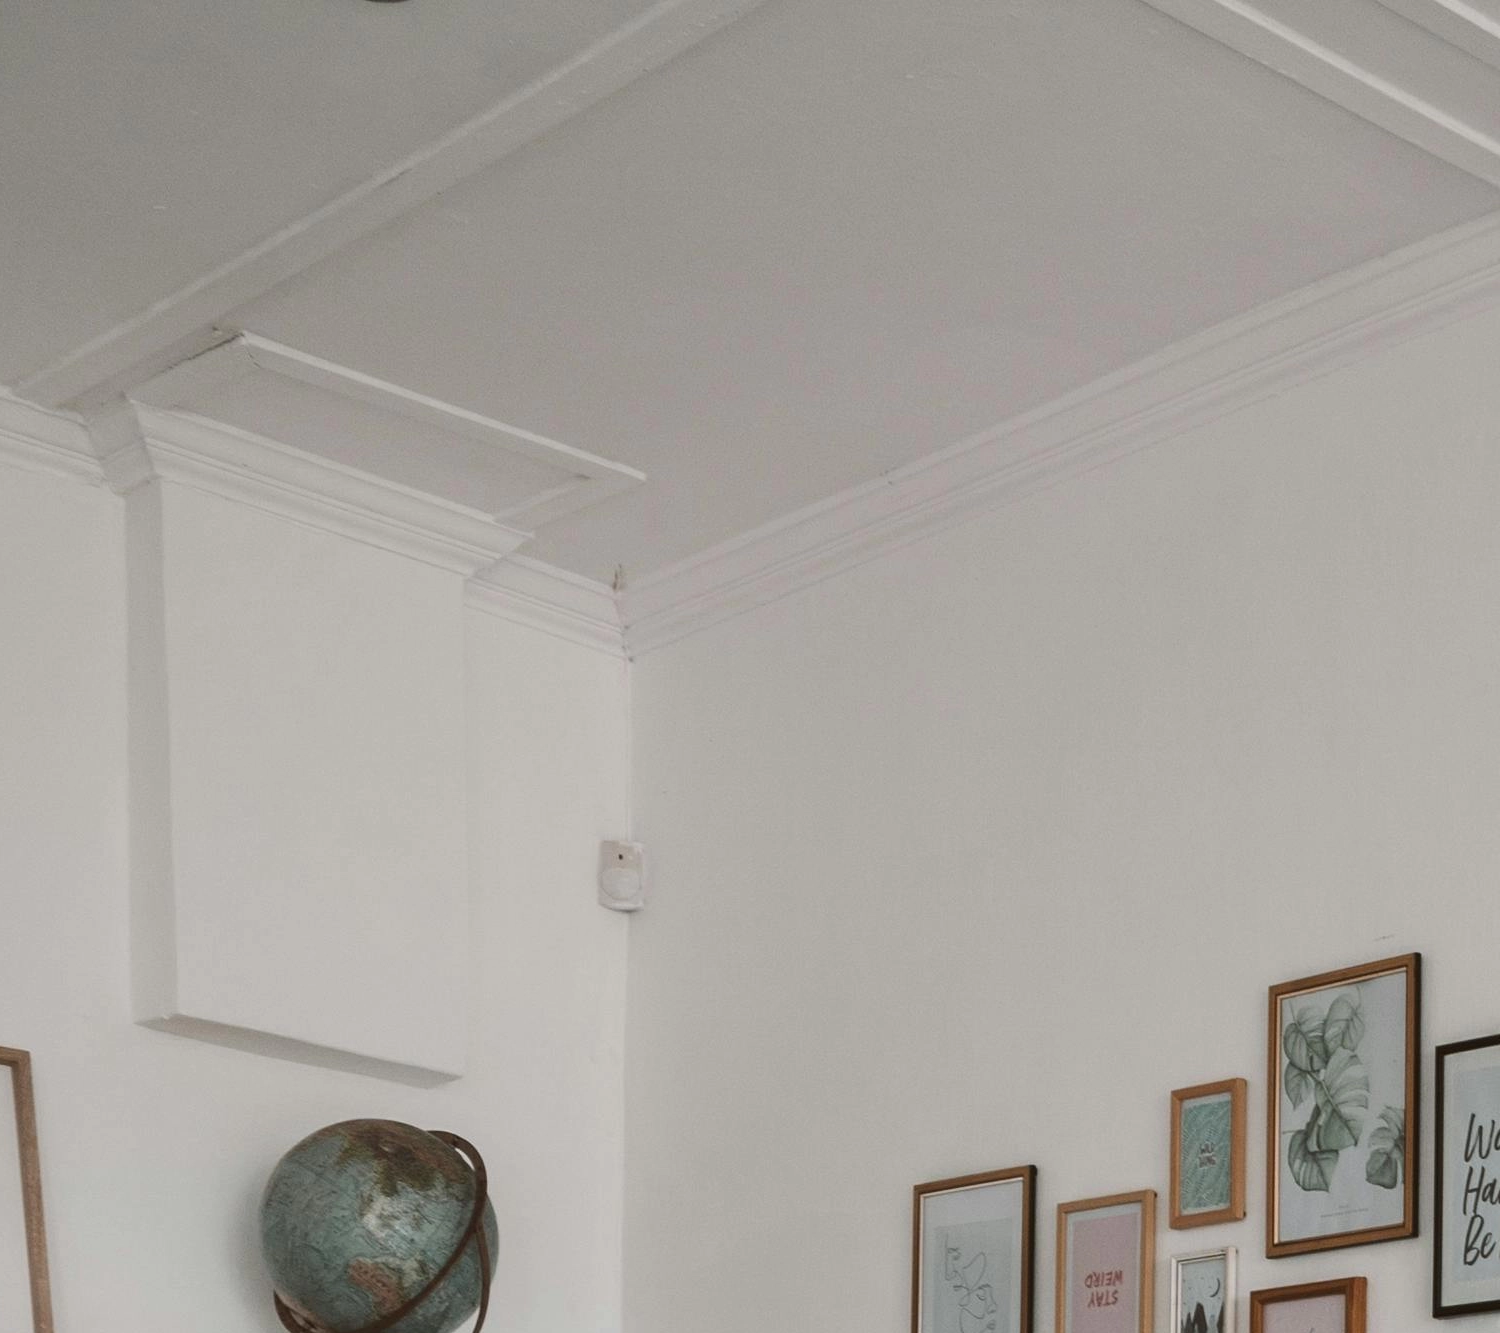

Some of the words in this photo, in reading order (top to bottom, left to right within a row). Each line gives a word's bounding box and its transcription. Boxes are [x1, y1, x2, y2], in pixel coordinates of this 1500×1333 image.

[1464, 1215, 1496, 1265] Be
[1084, 1271, 1123, 1289] WEIRD
[1087, 1291, 1119, 1307] STAY
